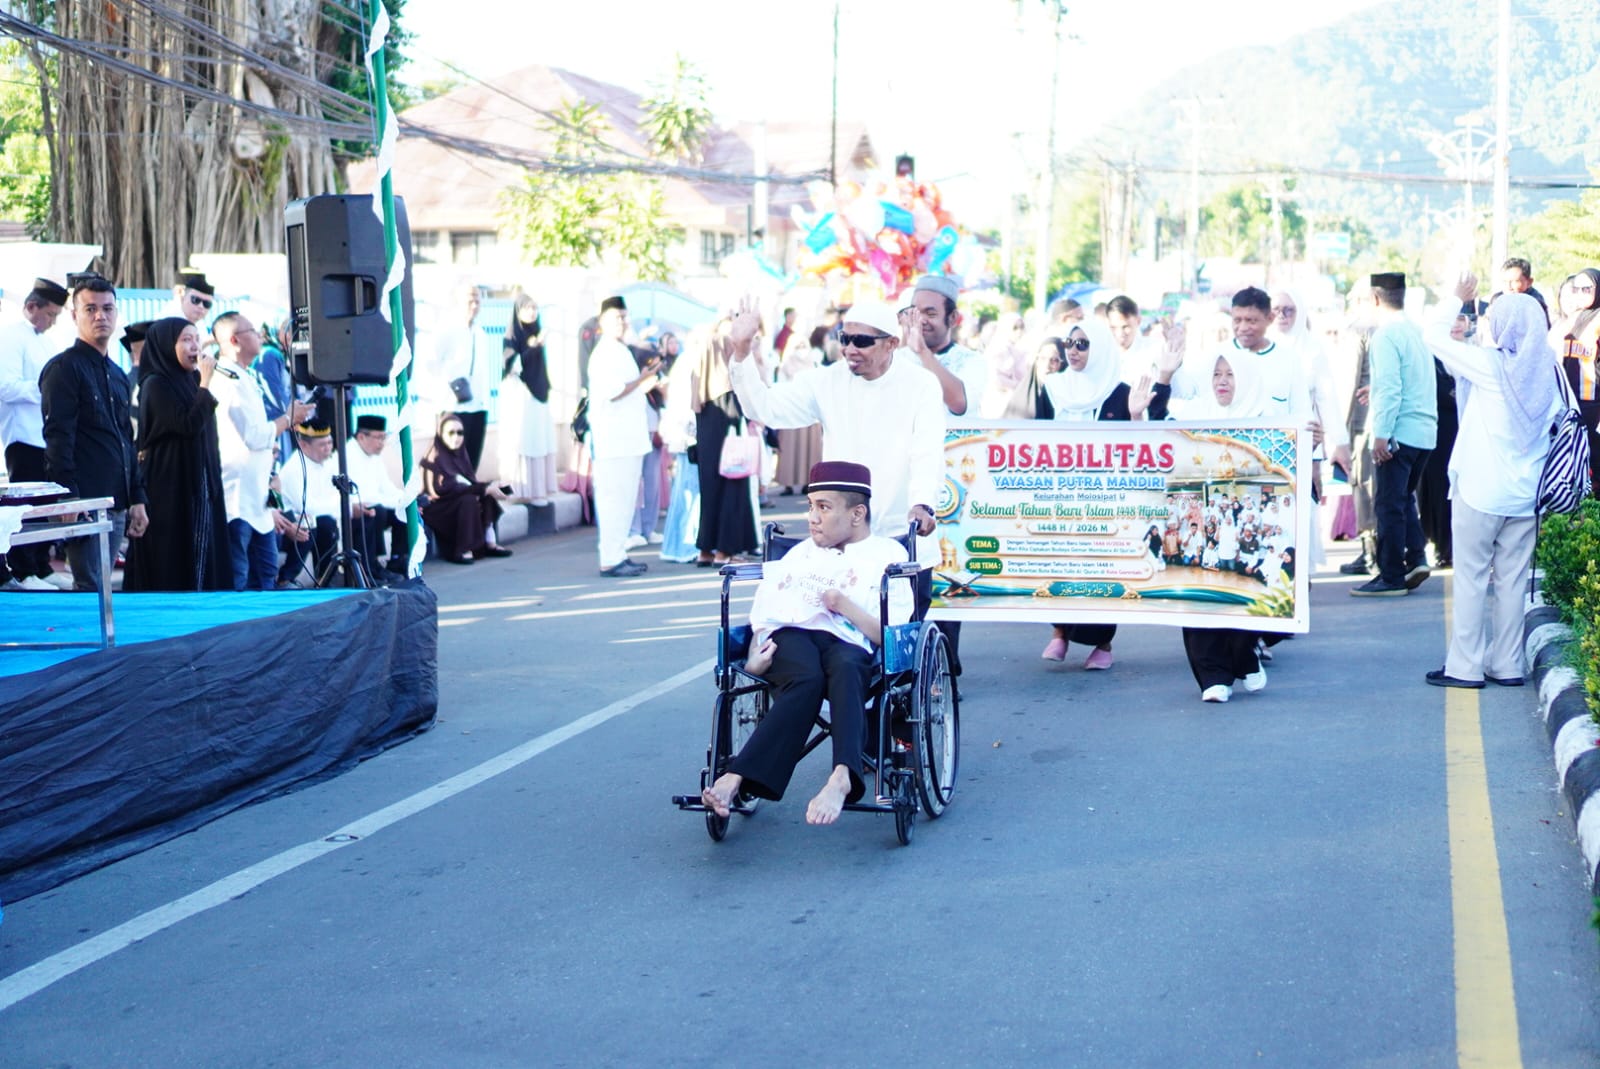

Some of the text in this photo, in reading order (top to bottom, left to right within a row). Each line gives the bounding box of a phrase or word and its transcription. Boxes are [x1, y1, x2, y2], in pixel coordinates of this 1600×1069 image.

[987, 443, 1175, 471] DISABILITAS
[993, 476, 1165, 490] YAYASAN PUTRA MANDIRI
[1033, 493, 1075, 501] Kelurahan
[970, 500, 1017, 518] Selamat
[1018, 502, 1052, 518] Tahun
[1054, 502, 1084, 519] Baru
[1084, 503, 1115, 519] Islam
[1115, 505, 1136, 519] 1448
[1037, 524, 1058, 532] 1448
[1059, 524, 1067, 532] H
[1076, 524, 1099, 533] 2026
[1100, 524, 1109, 533] M
[969, 562, 981, 570] SUB
